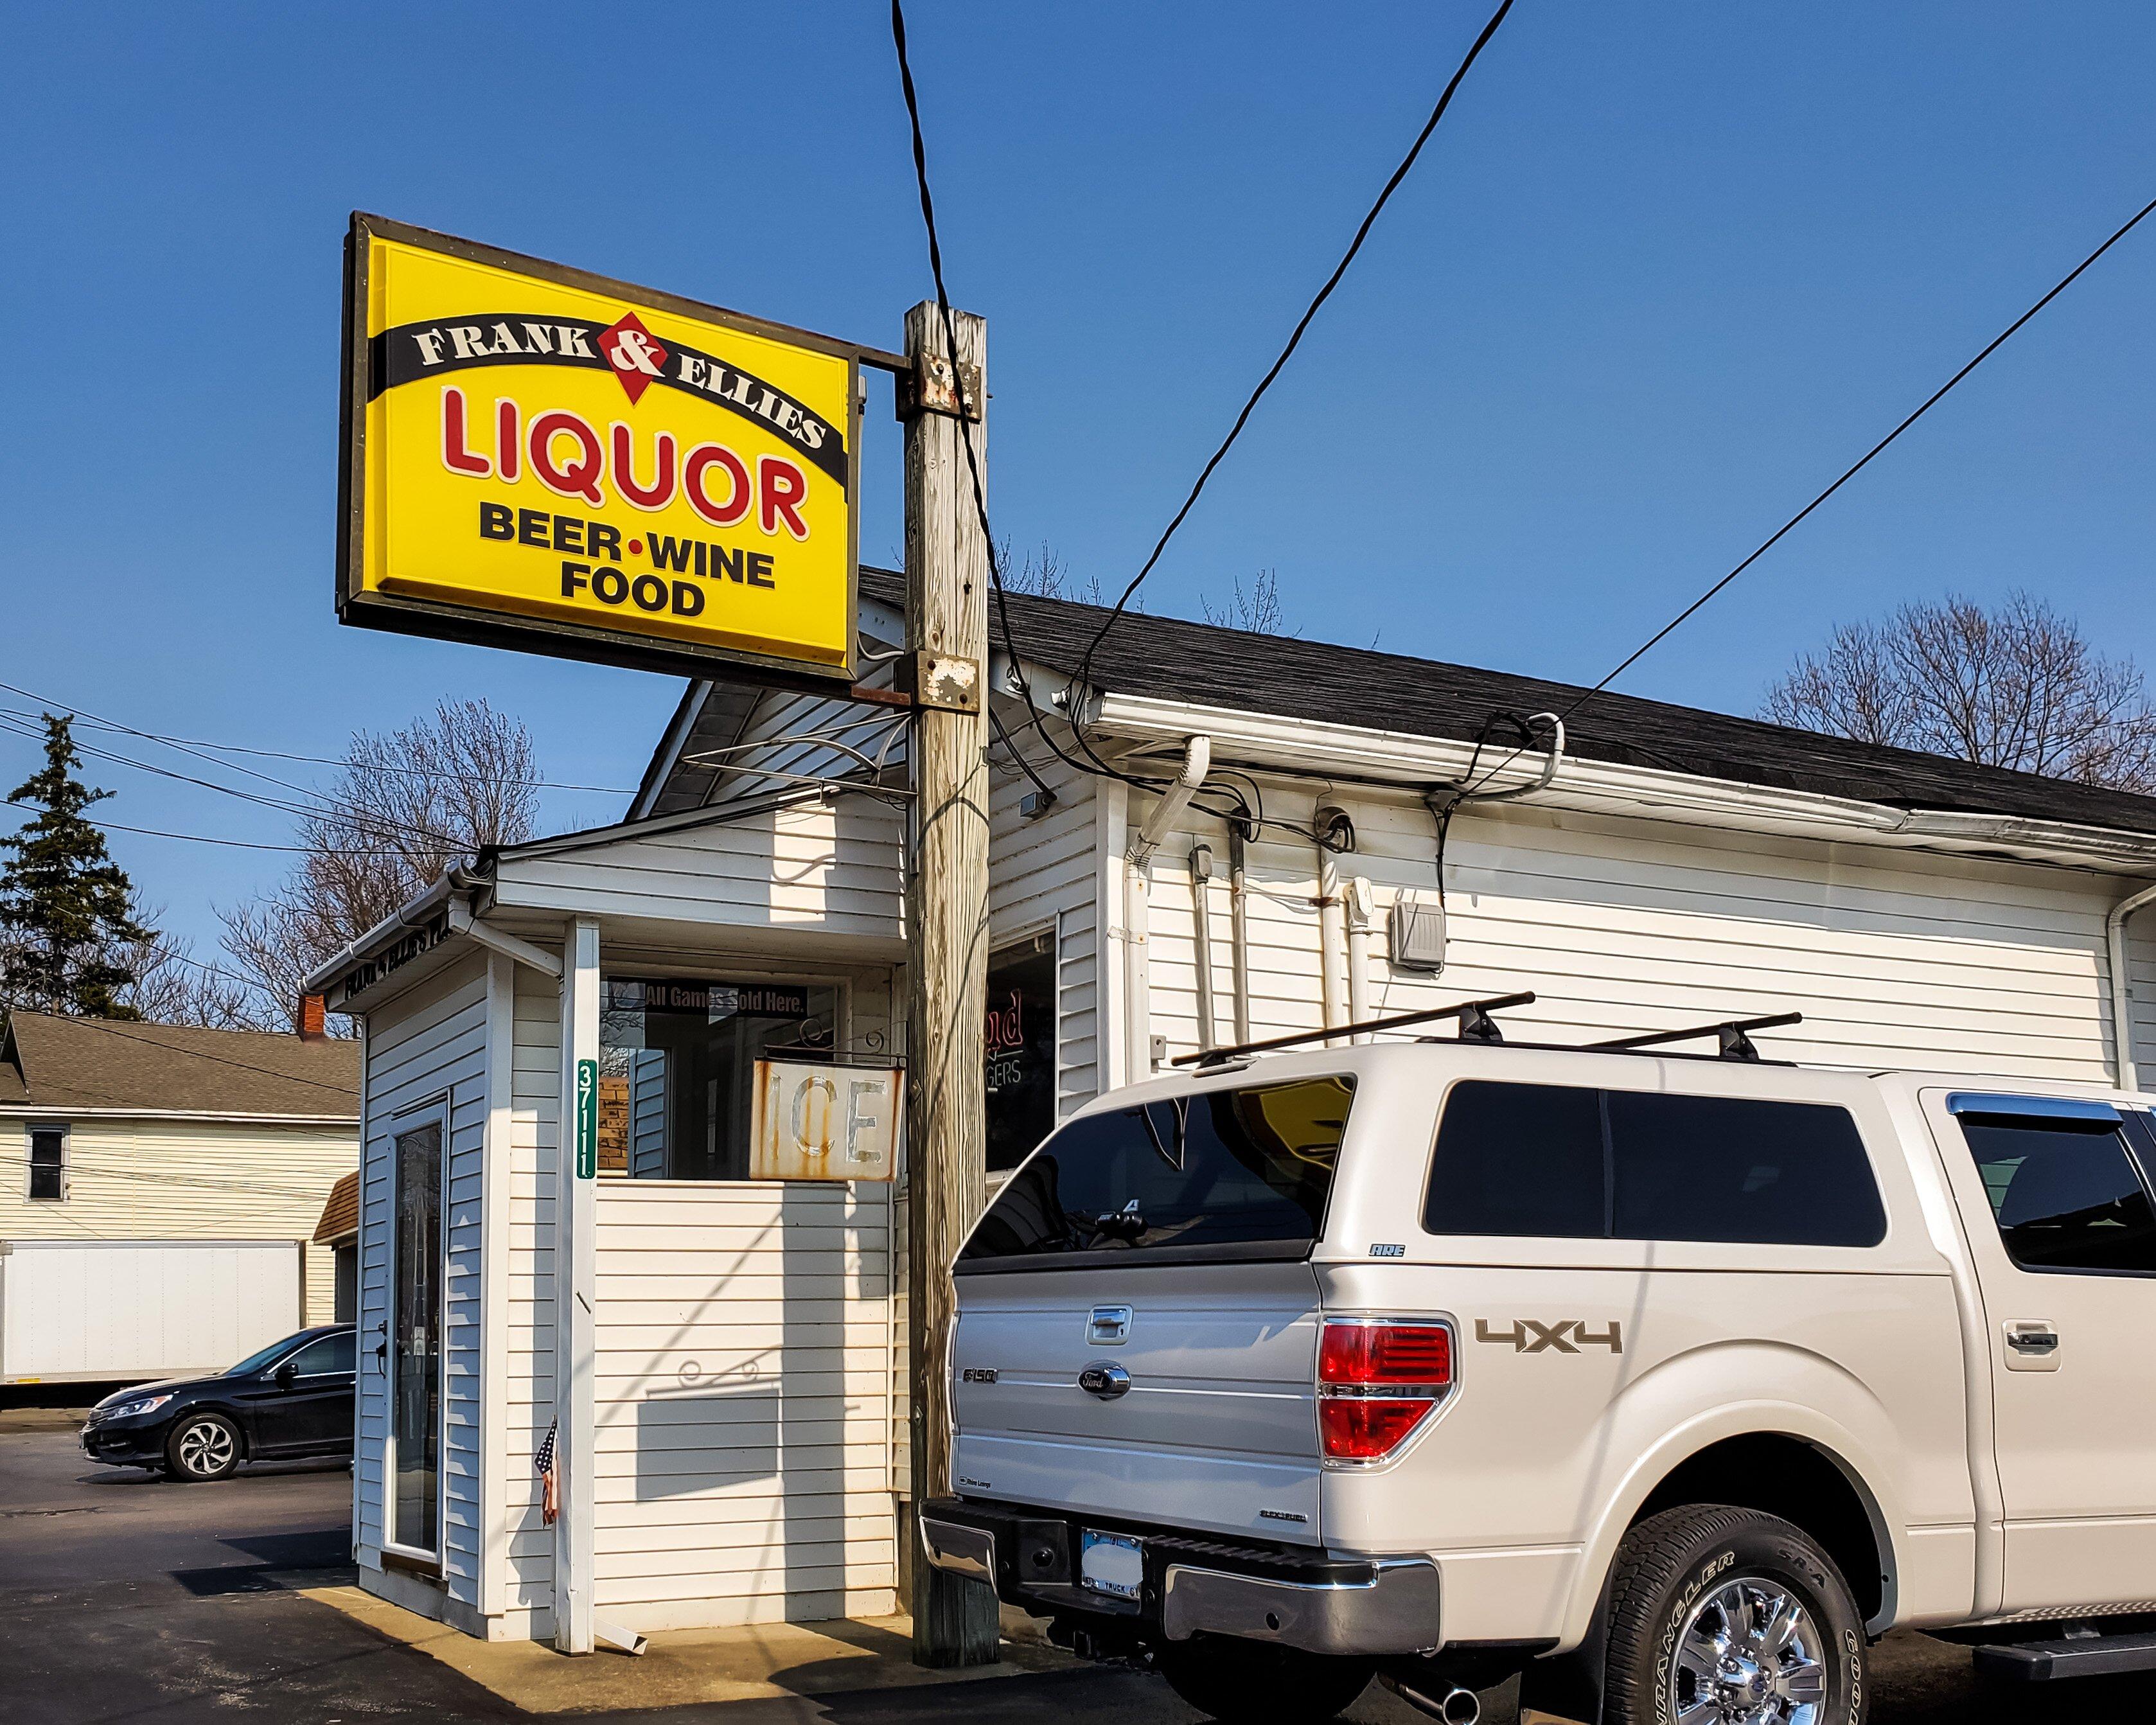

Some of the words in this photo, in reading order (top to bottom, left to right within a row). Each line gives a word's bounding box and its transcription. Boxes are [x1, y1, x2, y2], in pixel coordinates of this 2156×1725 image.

[411, 321, 597, 366] FRANK
[609, 330, 666, 378] &
[676, 352, 827, 450] ELLIES
[440, 385, 811, 542] LIQUOR
[479, 502, 623, 561] BEER
[646, 532, 775, 590] WINE
[560, 561, 705, 617] FOOD
[645, 986, 666, 1006] All
[670, 987, 723, 1009] Games
[727, 989, 761, 1011] Sold
[766, 991, 804, 1013] Here.
[986, 1059, 1021, 1086] GERS
[579, 1065, 592, 1176] 37111
[771, 1075, 887, 1164] ICE
[1370, 1244, 1405, 1257] ARE
[1082, 1372, 1103, 1388] Ford
[1105, 1582, 1126, 1592] TRUCK
